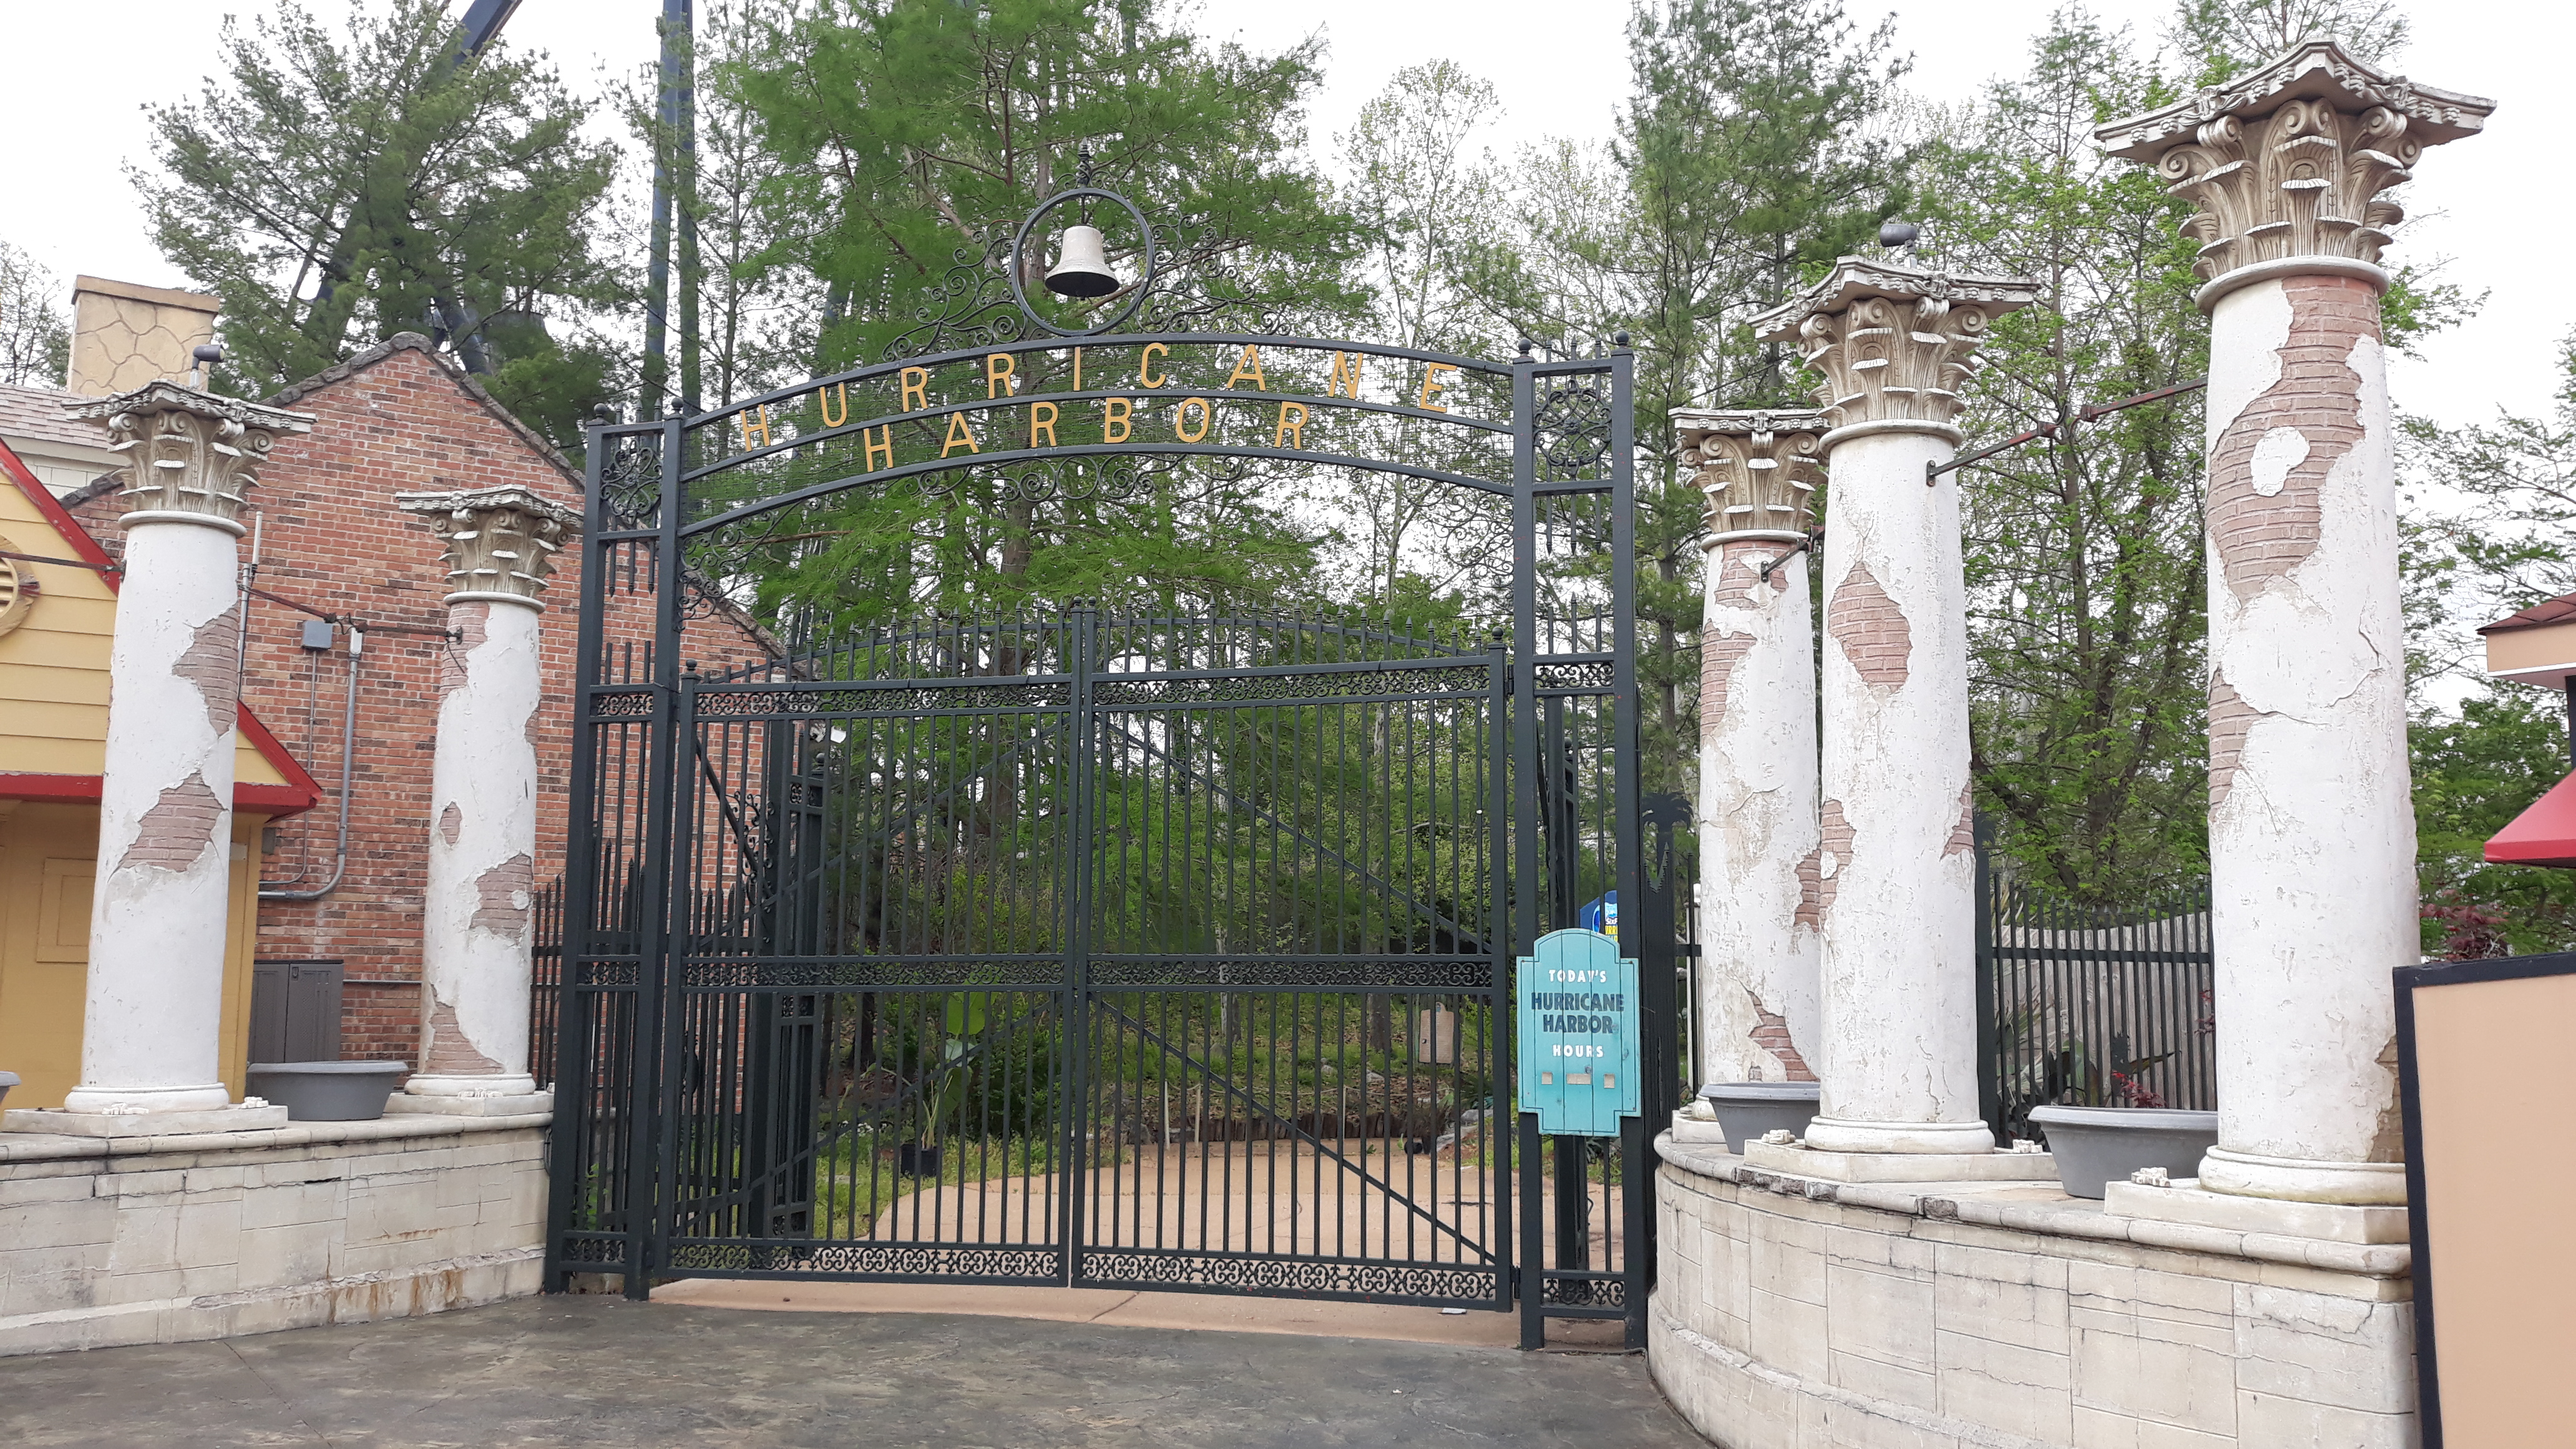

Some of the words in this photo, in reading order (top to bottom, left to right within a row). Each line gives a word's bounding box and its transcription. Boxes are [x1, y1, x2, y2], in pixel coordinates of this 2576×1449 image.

[739, 342, 1457, 452] HURRICANE
[863, 397, 1309, 472] HARBOR
[1549, 969, 1606, 983] TODAY'S
[1531, 992, 1624, 1012] HURRICANE
[1543, 1014, 1612, 1034] HARBOR
[1552, 1044, 1604, 1058] HOURS
